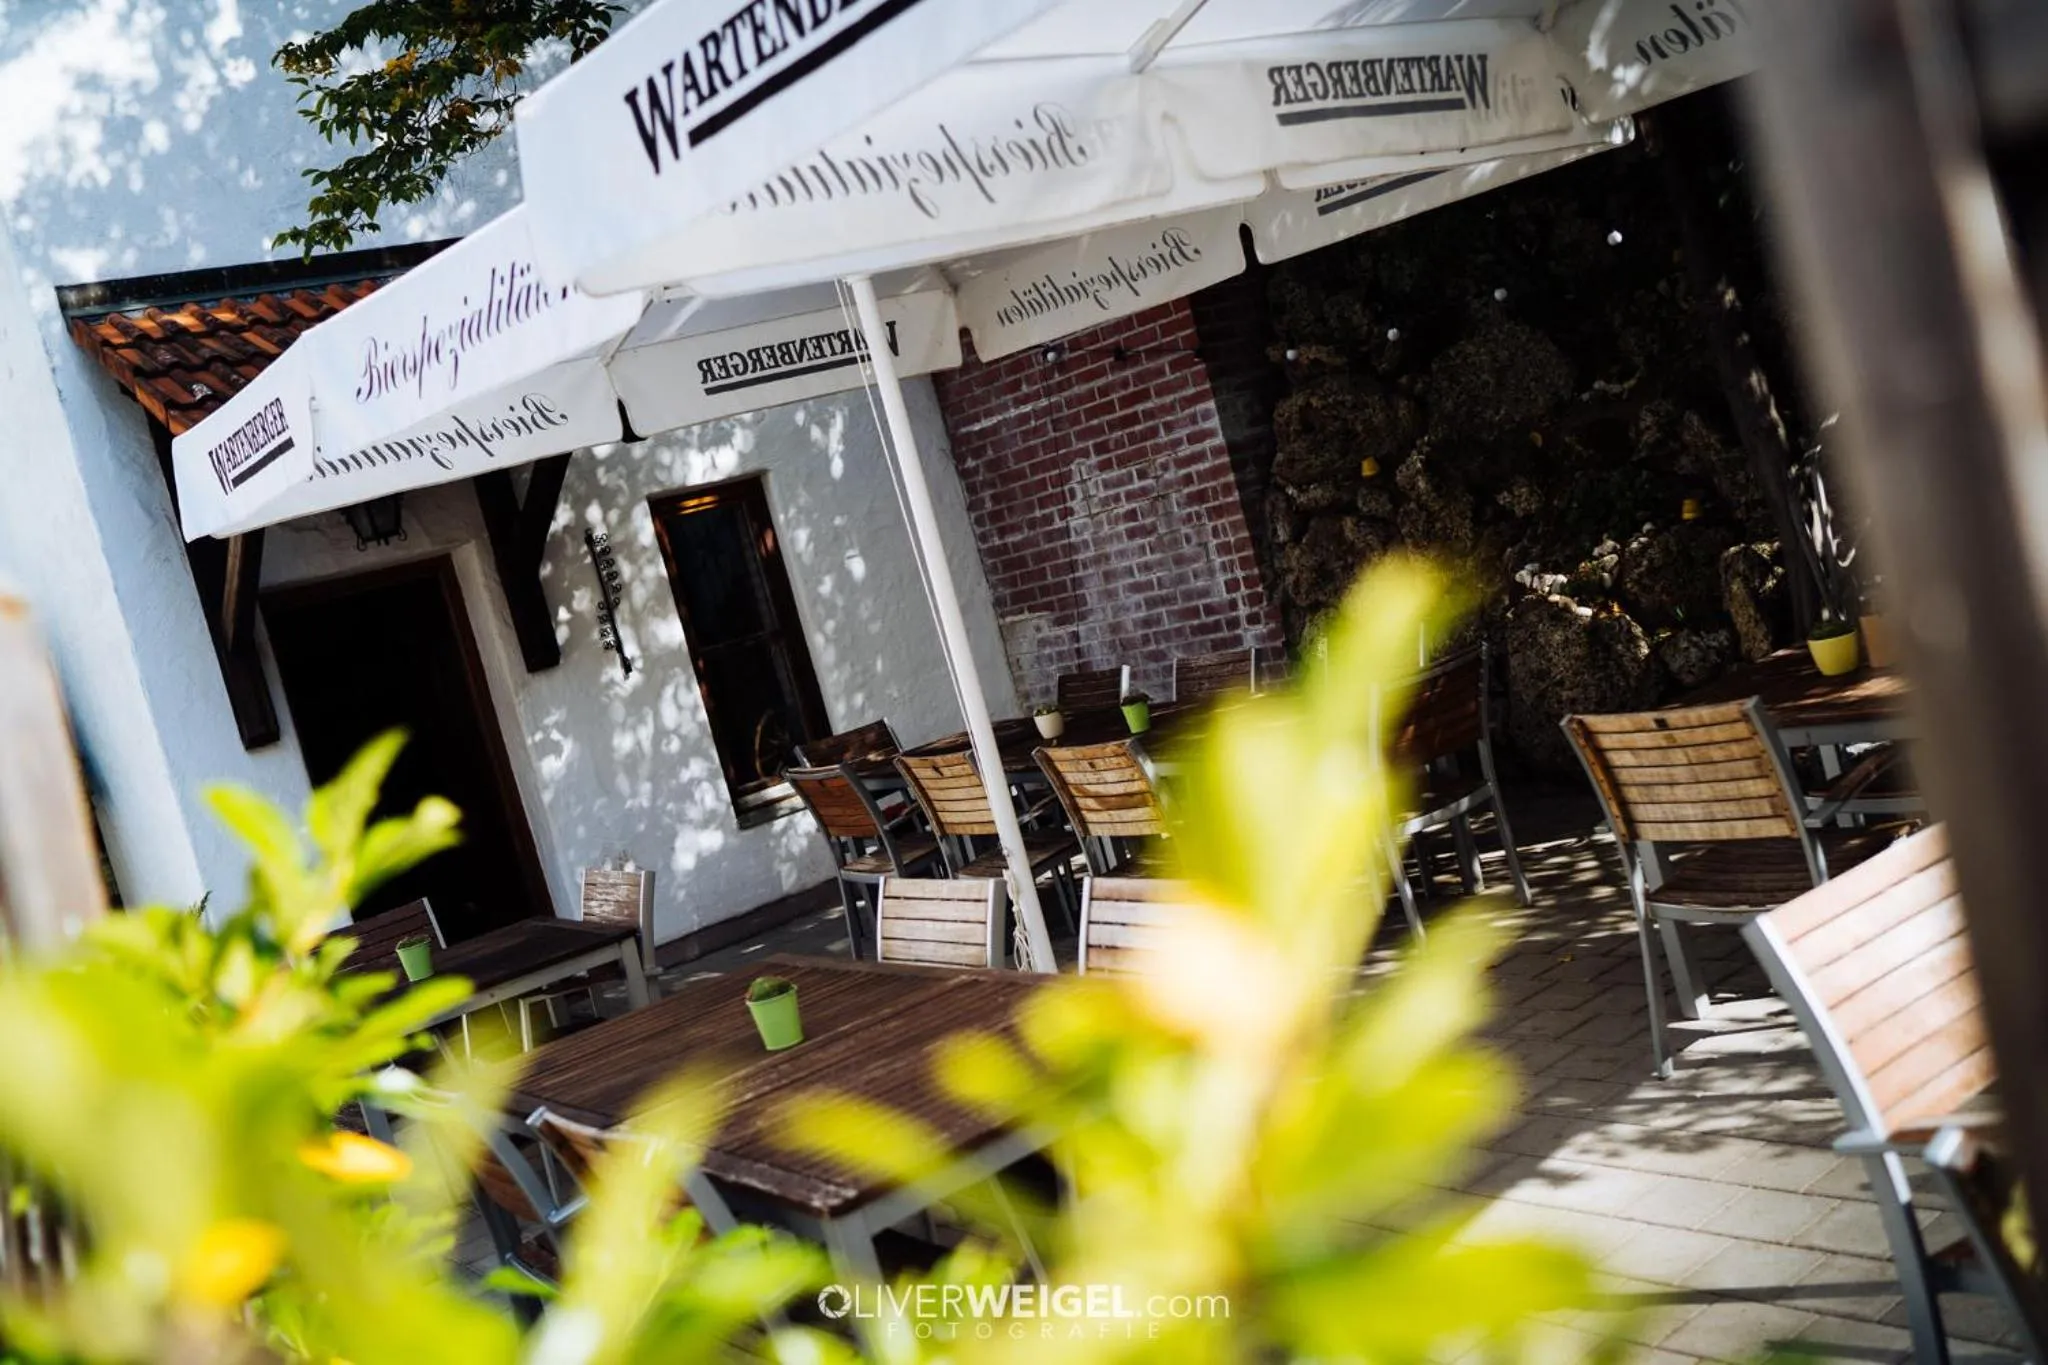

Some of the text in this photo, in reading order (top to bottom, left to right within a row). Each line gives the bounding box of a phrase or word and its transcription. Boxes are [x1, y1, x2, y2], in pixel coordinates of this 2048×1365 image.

[624, 0, 862, 176] WARTEN
[356, 260, 578, 403] Bierspezialitä
[208, 397, 289, 496] WARTENBERGER
